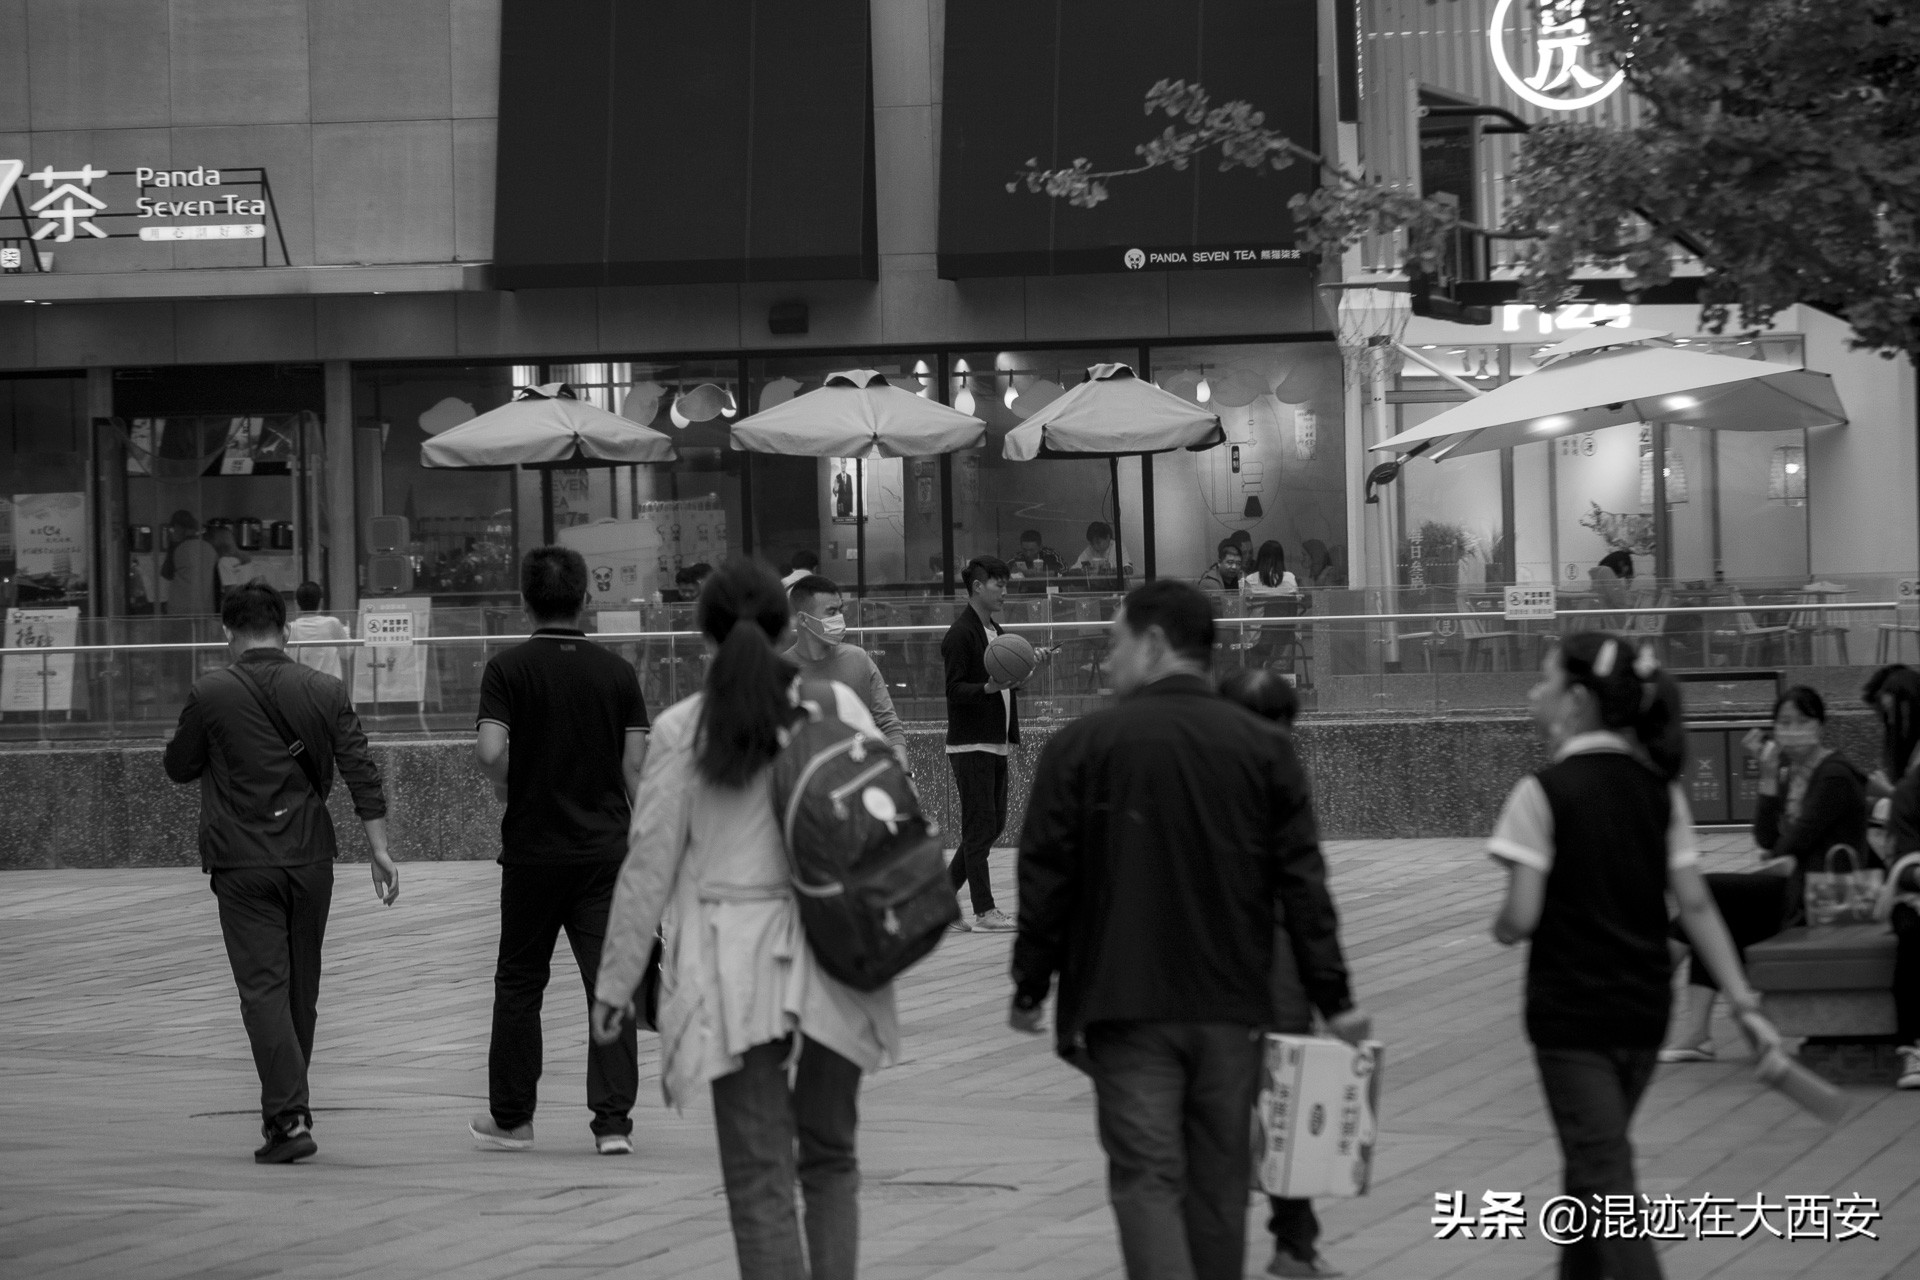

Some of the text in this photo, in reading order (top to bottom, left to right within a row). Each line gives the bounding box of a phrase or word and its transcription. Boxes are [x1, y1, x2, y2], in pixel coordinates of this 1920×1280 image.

[136, 165, 221, 188] Panda
[136, 194, 266, 218] Seven Tea
[1150, 252, 1188, 264] PANDA
[1192, 251, 1230, 263] SEVEN
[1233, 249, 1257, 261] TEA
